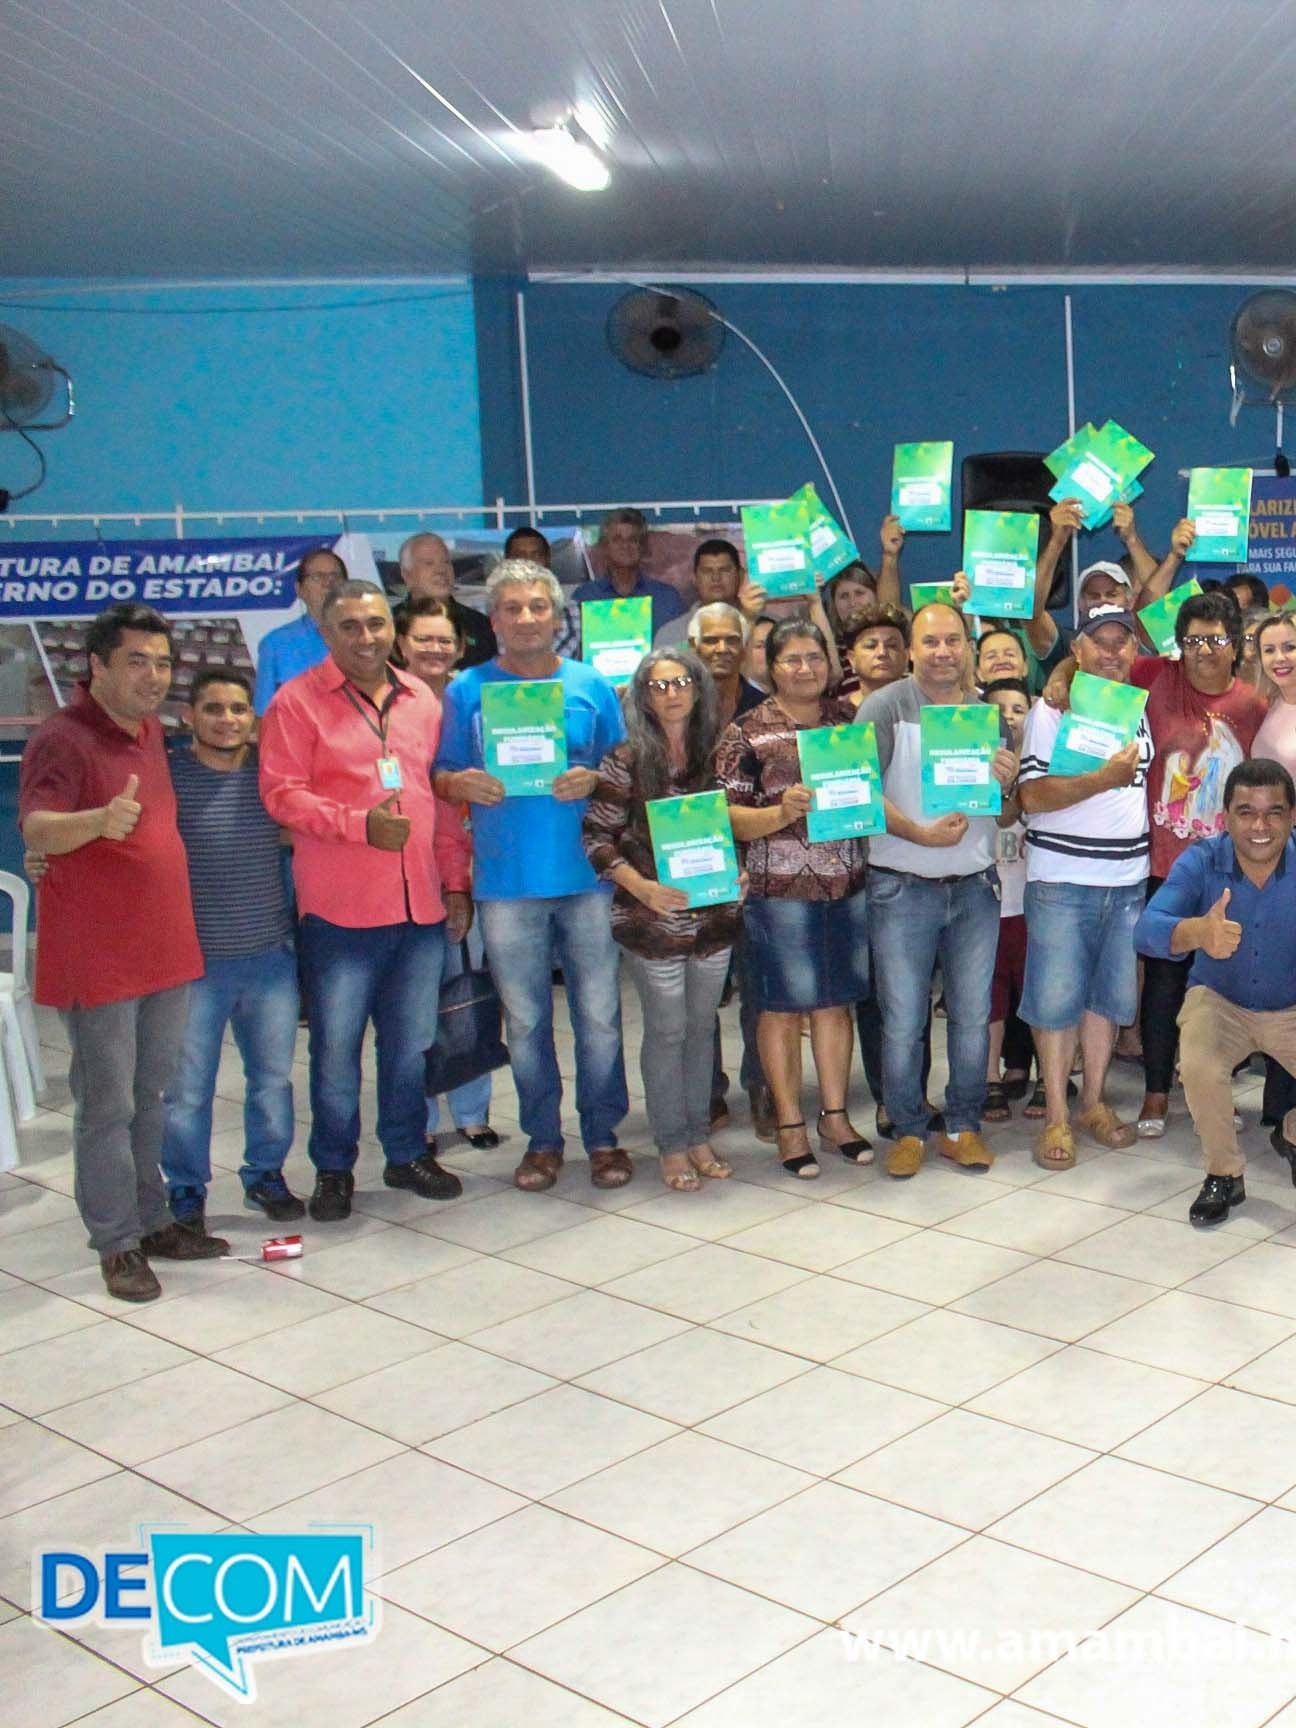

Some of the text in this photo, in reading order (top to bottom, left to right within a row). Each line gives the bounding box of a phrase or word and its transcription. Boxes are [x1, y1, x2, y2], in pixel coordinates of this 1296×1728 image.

[89, 556, 131, 576] DE
[137, 552, 285, 575] AMAMBAI
[1263, 562, 1281, 573] SUA
[85, 580, 136, 600] DO
[143, 576, 282, 599] ESTADO:
